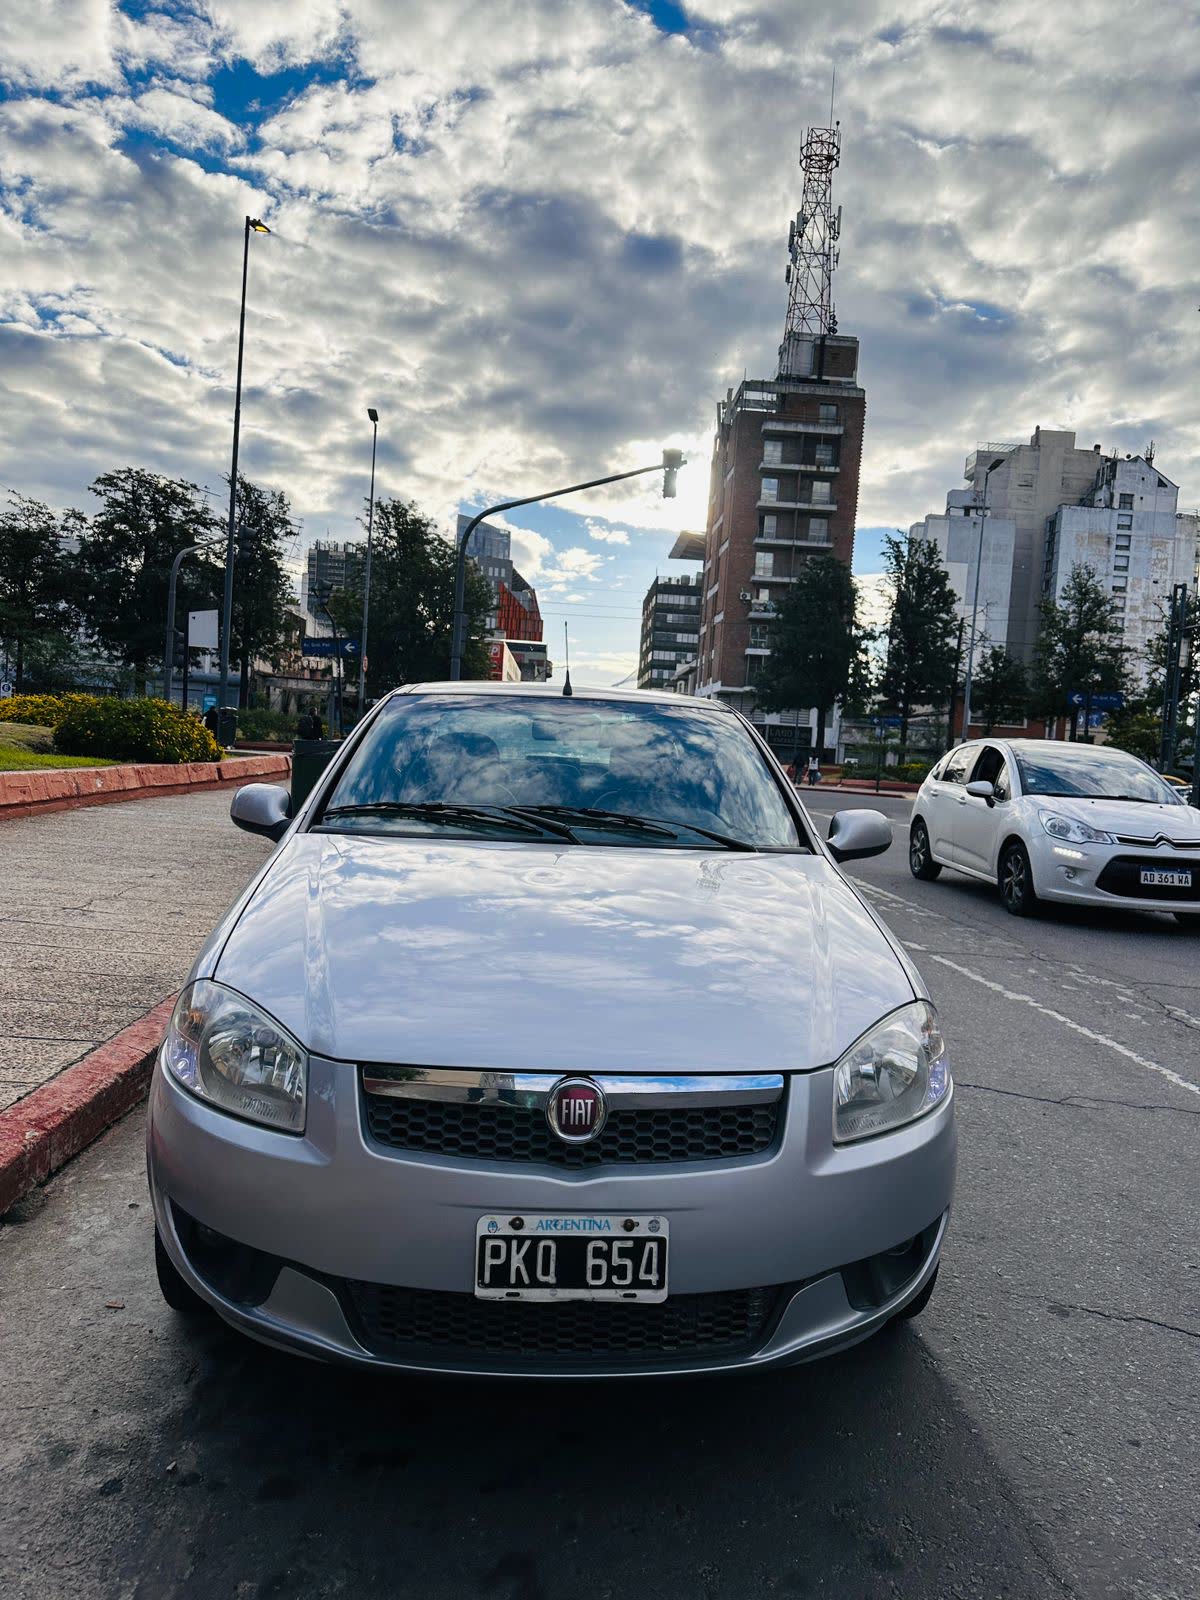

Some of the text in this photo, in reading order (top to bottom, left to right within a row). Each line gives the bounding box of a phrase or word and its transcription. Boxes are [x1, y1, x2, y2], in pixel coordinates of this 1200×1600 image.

[1143, 872, 1155, 883] AD
[1157, 873, 1176, 884] 361
[561, 1098, 594, 1125] FIAT
[536, 1219, 611, 1232] ARGENTINA
[484, 1238, 659, 1286] PKQ 654
